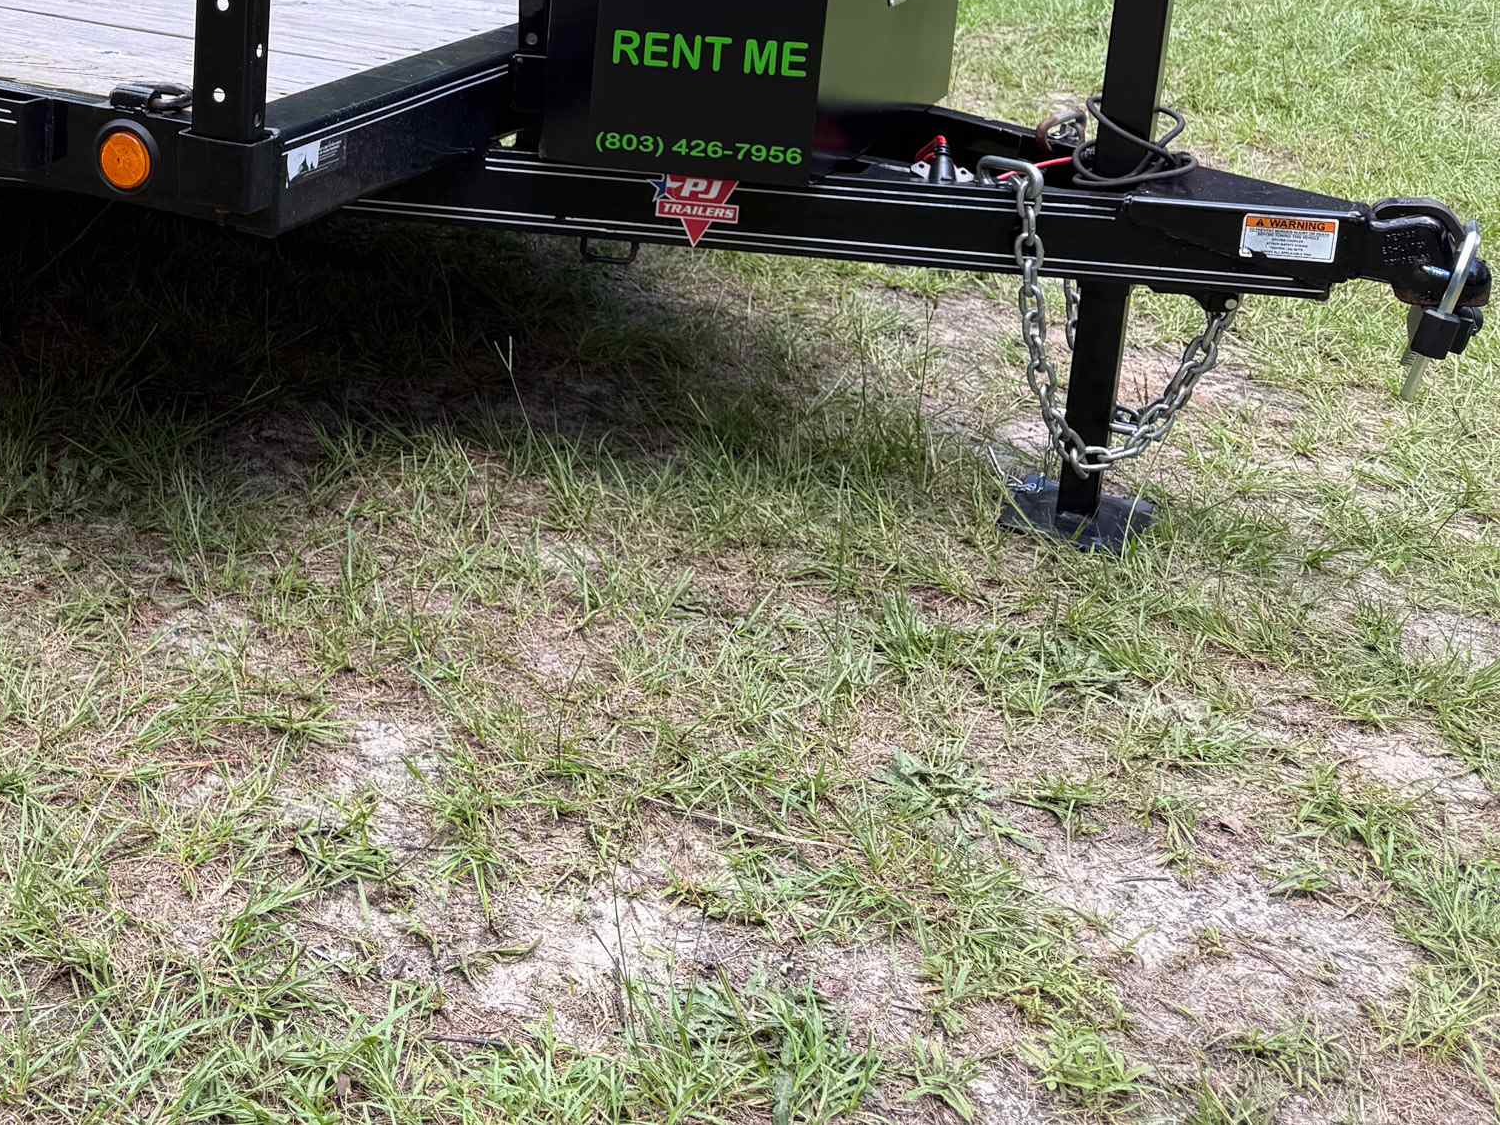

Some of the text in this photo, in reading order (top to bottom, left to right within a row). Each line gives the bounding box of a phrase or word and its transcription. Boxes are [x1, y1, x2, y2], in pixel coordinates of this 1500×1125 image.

[612, 29, 809, 77] RENT ME
[595, 131, 803, 165] (803) 426-7956
[680, 177, 723, 199] PJ
[662, 202, 735, 219] TRAILERS
[1269, 219, 1326, 231] WARNING
